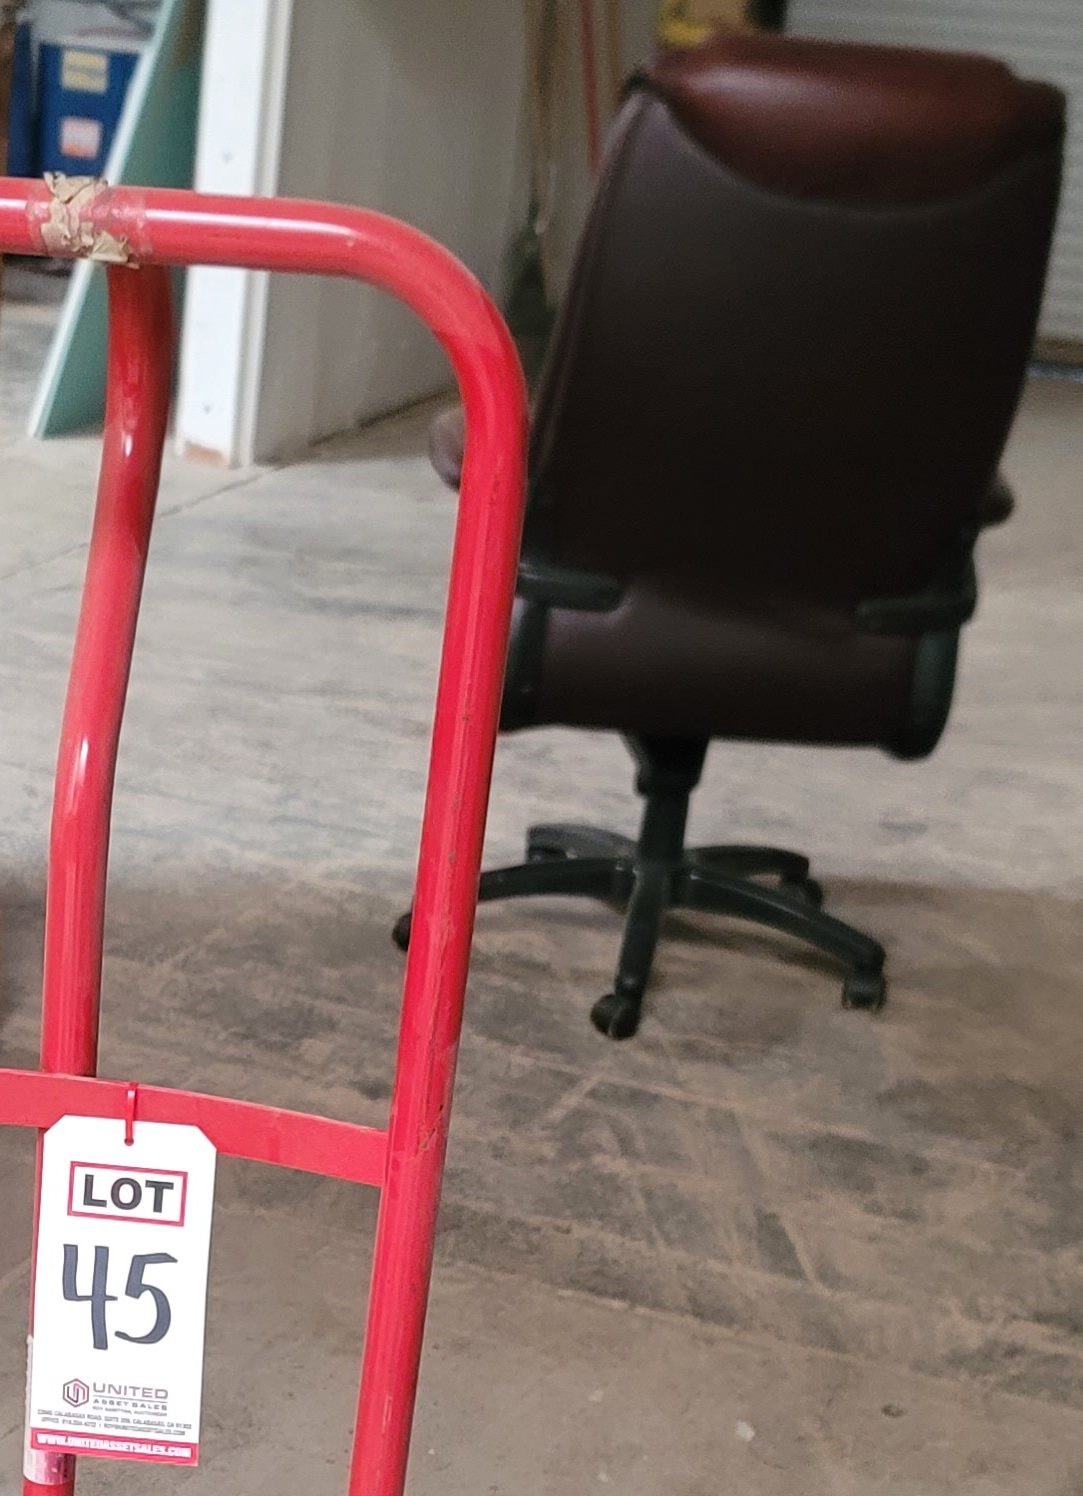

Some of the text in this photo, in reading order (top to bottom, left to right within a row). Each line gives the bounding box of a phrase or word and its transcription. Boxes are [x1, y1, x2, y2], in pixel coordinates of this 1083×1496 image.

[82, 1174, 175, 1214] LOT
[61, 1243, 179, 1351] 45
[92, 1381, 169, 1400] UNITED
[93, 1398, 168, 1411] ASSET SALES
[36, 1432, 192, 1459] WWW.UNITEDASSETSALES.COM
